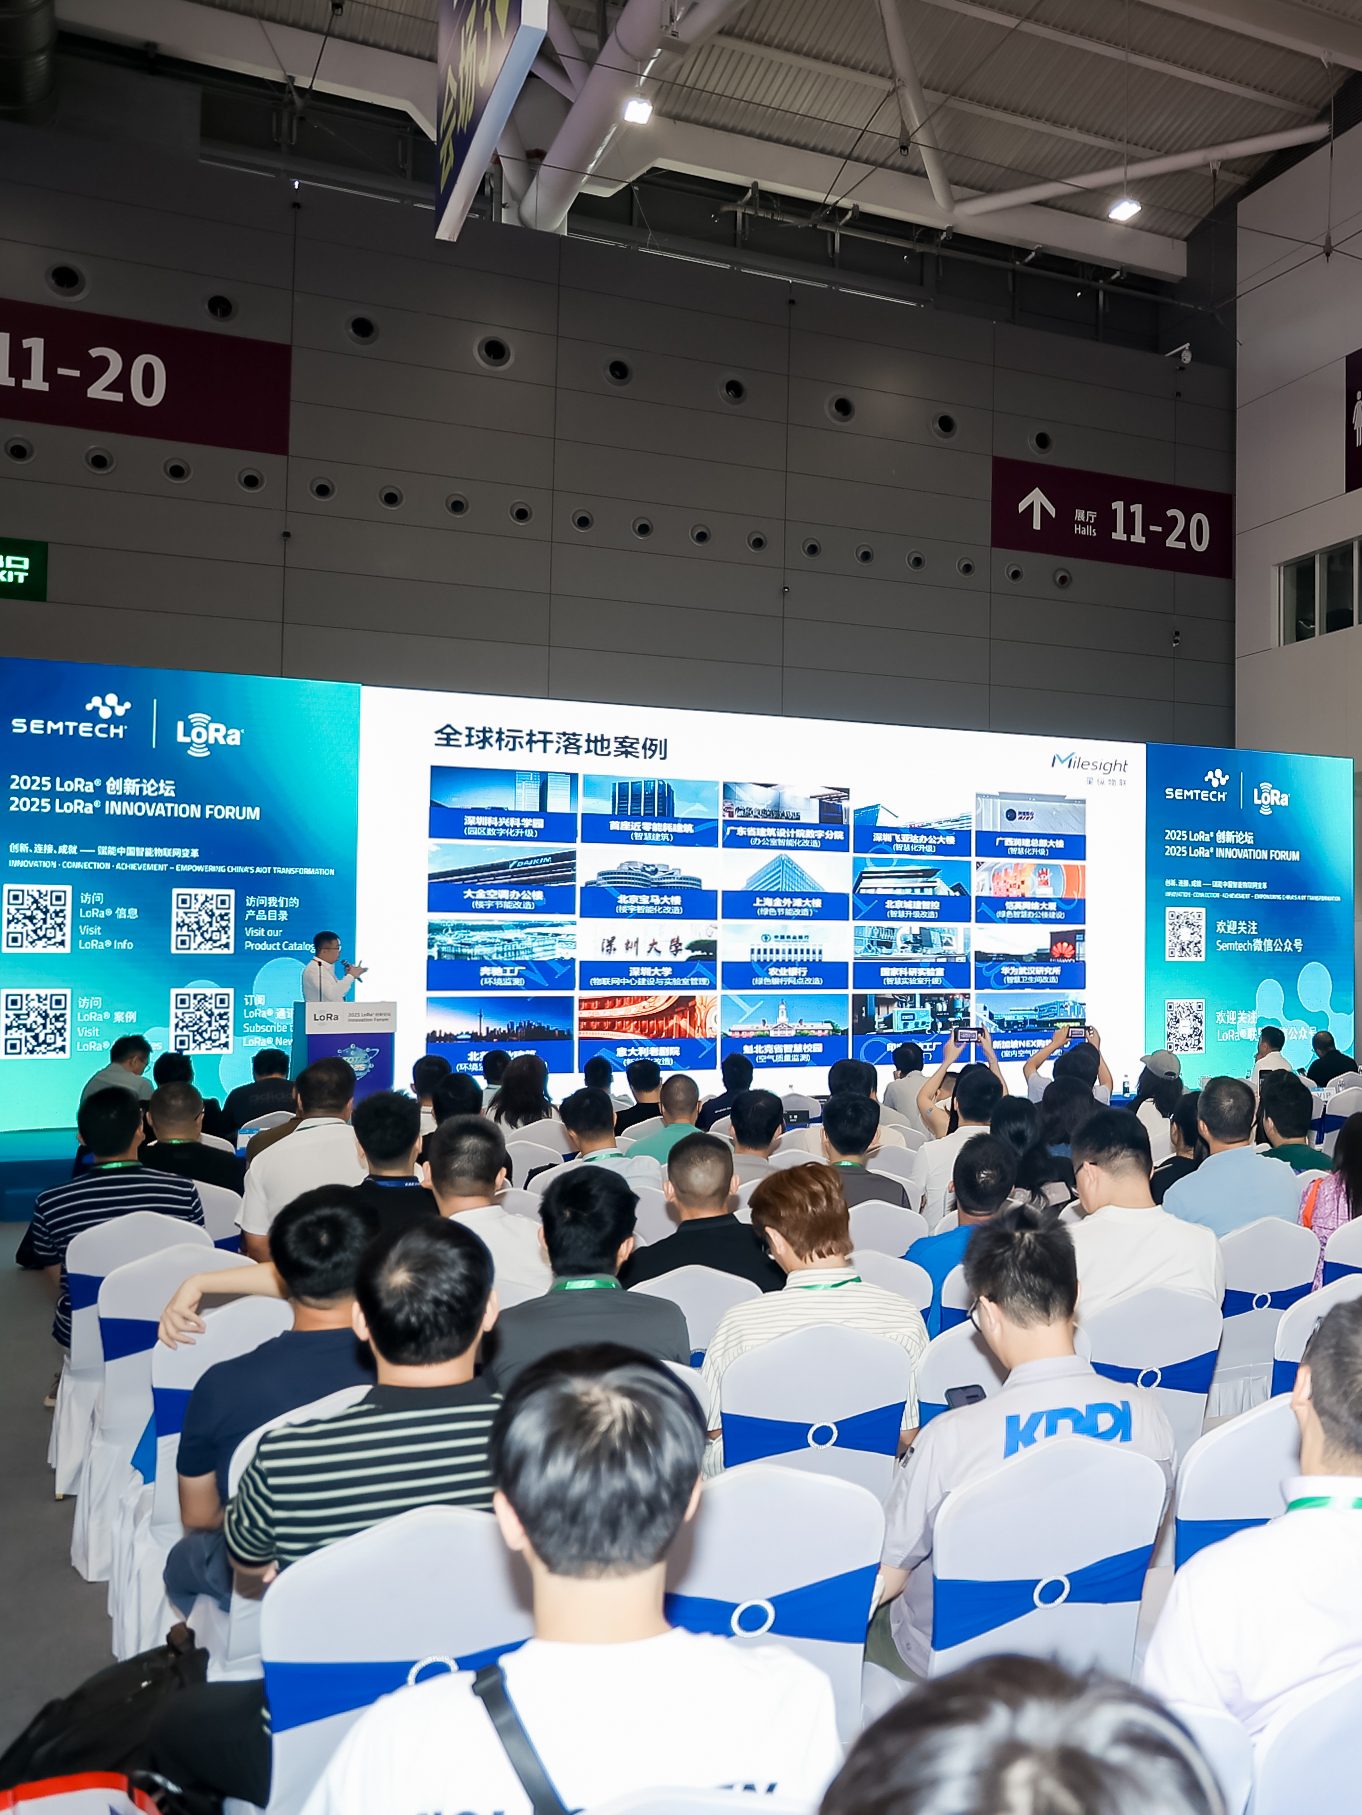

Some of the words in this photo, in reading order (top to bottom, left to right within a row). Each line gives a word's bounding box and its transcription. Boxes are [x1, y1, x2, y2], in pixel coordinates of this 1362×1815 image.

[1075, 509, 1097, 523] 展厅
[1075, 524, 1097, 537] Halls
[1111, 500, 1210, 552] 11-20
[0, 555, 29, 570] 口
[11, 718, 125, 739] SEMTECH
[177, 720, 242, 746] LoRa
[434, 723, 668, 760] 全球标杆落地案例
[1051, 752, 1128, 775] Milesight
[10, 775, 51, 791] 2025
[106, 777, 176, 797] 创新论坛
[1165, 788, 1226, 802] SEMTECH
[1254, 788, 1289, 807] LoRa
[9, 797, 51, 813] 2025
[105, 801, 200, 818] INNOVATION
[205, 805, 260, 820] FORUM
[1165, 830, 1187, 841] 2025
[1216, 830, 1254, 844] 创新论坛
[1165, 846, 1187, 857] 2025
[1216, 848, 1268, 860] INNOVATION
[1270, 850, 1300, 861] FORUM
[9, 860, 56, 868] INNOVATION
[62, 861, 110, 870] CONNECTION
[115, 862, 168, 871] ACHIEVEMENT
[176, 864, 225, 873] EMPOWERING
[273, 867, 335, 875] TRANSFORMATION
[80, 893, 104, 905] 访问
[245, 896, 299, 908] 访问我们的
[115, 907, 139, 919] 信息
[245, 910, 288, 921] 产品目录
[79, 925, 101, 935] Visit
[245, 927, 265, 937] Visit
[267, 928, 283, 937] our
[1216, 920, 1258, 935] 欢迎关注
[114, 940, 133, 950] Info
[245, 941, 280, 951] Product
[1216, 938, 1303, 953] Semtech微信公众号
[78, 997, 102, 1009] 访问
[244, 994, 265, 1006] 订阅
[113, 1011, 136, 1023] 案例
[314, 1013, 339, 1021] LoRa
[1215, 1010, 1257, 1024] 欢迎关注
[77, 1026, 99, 1037] Visit
[243, 1023, 287, 1033] Subscribe
[1003, 1400, 1132, 1459] KDDI
